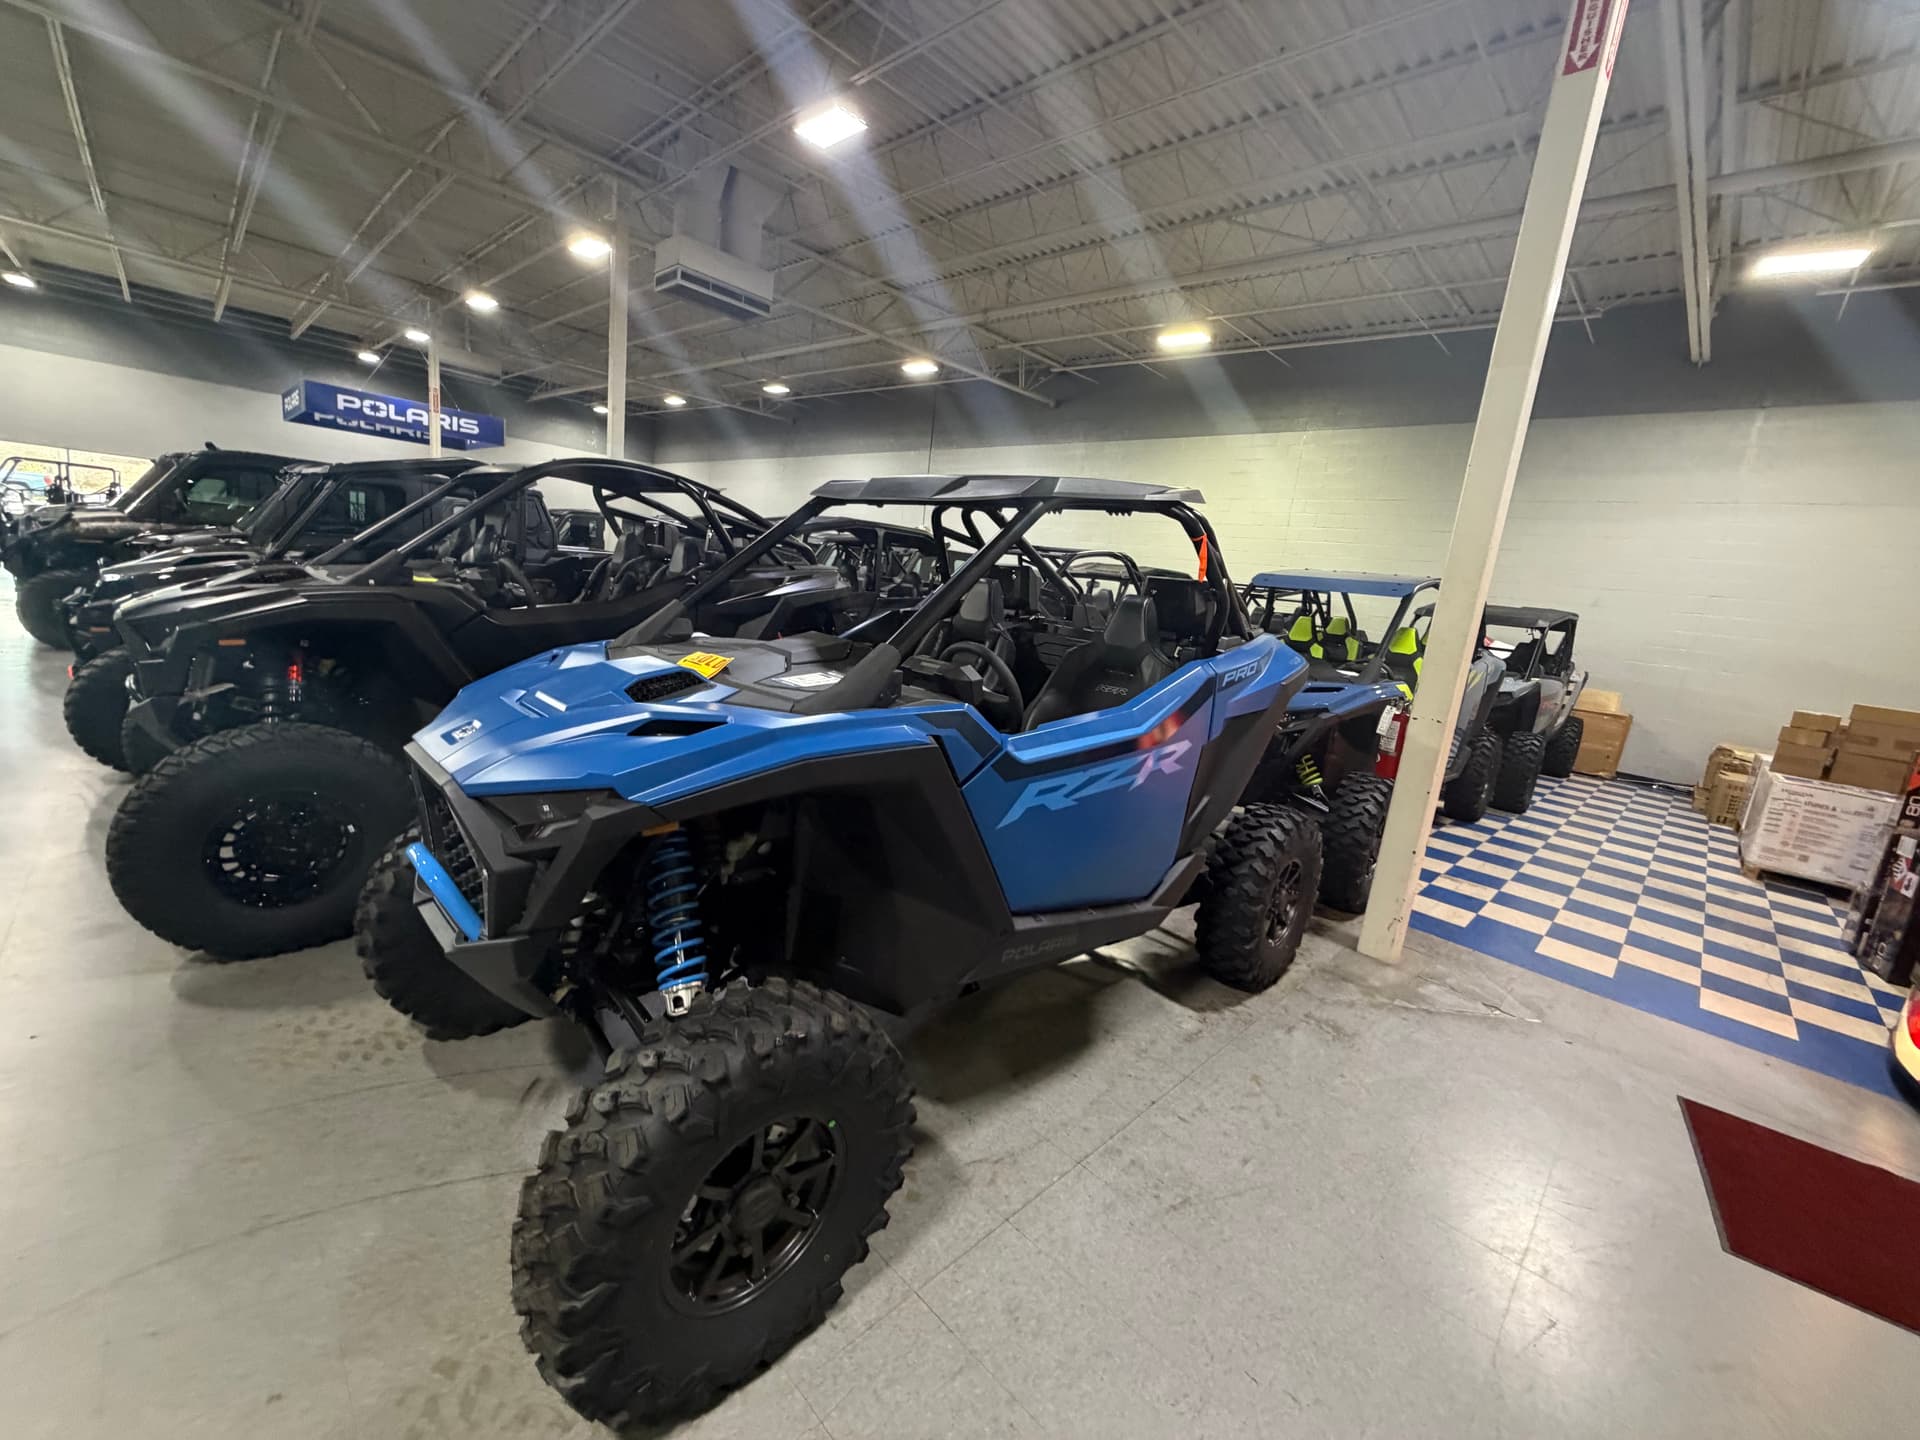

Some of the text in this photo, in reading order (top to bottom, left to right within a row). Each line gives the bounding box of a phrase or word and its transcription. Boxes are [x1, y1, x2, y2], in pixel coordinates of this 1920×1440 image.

[336, 393, 479, 435] POLARIS
[1221, 661, 1259, 687] PRO
[995, 740, 1192, 829] RZR
